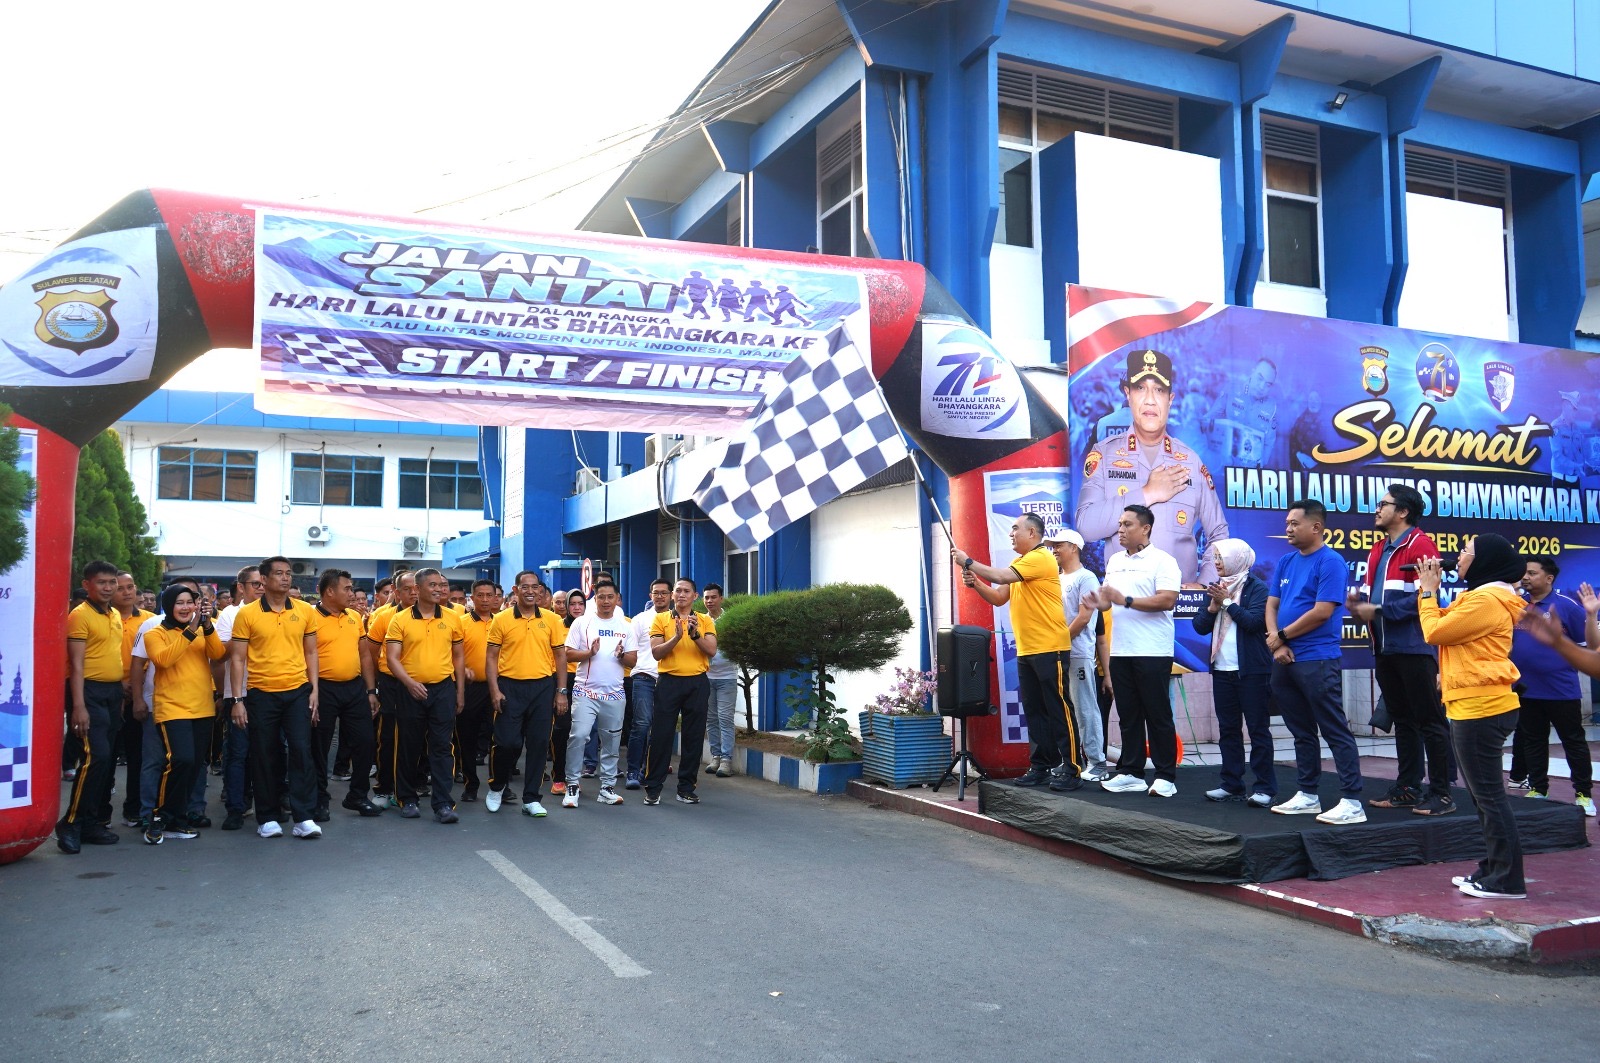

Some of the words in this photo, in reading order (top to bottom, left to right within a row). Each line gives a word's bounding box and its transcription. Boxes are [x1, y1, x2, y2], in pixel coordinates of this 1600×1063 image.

[342, 242, 583, 278] JALAN
[36, 277, 77, 290] SULAWESI
[78, 276, 116, 287] SELATAN
[357, 265, 675, 310] SANTAI
[268, 292, 357, 313] HARI
[363, 300, 448, 321] LALU
[453, 308, 560, 332] LINTAS
[566, 318, 776, 348] BHAYANGKARA
[526, 306, 592, 318] DALAM
[598, 312, 671, 325] RANGKA
[424, 324, 490, 337] LINTAS
[495, 330, 574, 343] MODERN
[580, 337, 639, 348] UNTUK
[644, 342, 733, 355] INDONESIA
[397, 347, 579, 380] START
[616, 360, 781, 395] FINISH
[937, 402, 1001, 410] BHAYANGKARA
[1311, 400, 1550, 466] Selamat
[1022, 502, 1063, 513] TERTIB
[1226, 466, 1288, 510] HARI
[1293, 471, 1351, 513] LALU
[1436, 480, 1584, 524] BHAYANGKARA
[1585, 489, 1600, 524] K
[1322, 528, 1346, 549] 22
[1517, 535, 1561, 556] 2026
[1178, 593, 1194, 603] Puro,
[598, 629, 627, 639] BRImo
